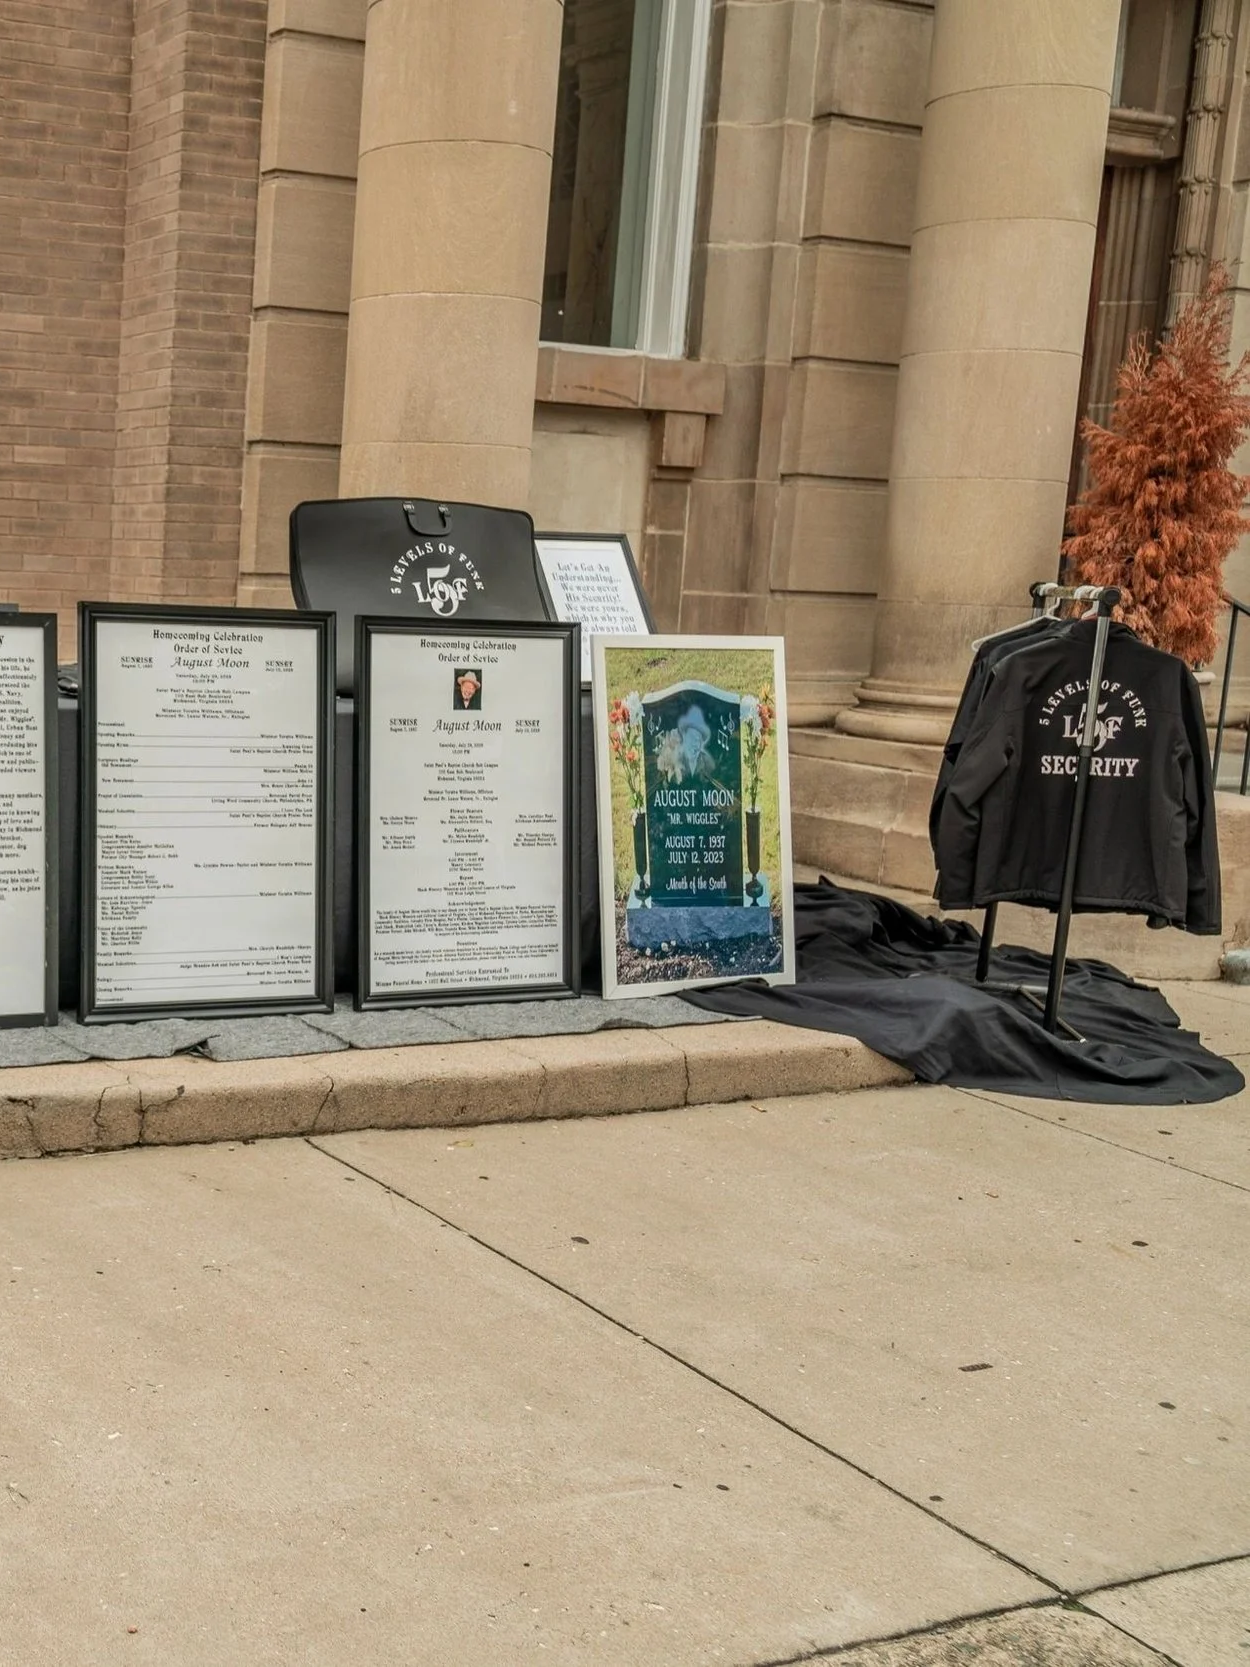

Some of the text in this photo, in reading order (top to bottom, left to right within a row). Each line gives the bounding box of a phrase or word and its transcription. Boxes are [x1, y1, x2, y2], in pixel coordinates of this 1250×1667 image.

[390, 542, 433, 583] LEVELS
[439, 543, 455, 555] OF
[459, 553, 484, 590] FUNK
[557, 562, 610, 572] Let's Get An
[560, 583, 574, 591] We
[565, 593, 621, 603] His Security!
[565, 603, 579, 612] We
[591, 614, 598, 622] is
[600, 614, 617, 623] why
[620, 616, 635, 624] you
[591, 624, 637, 633] always told
[153, 629, 264, 643] Homecoming Celebration
[173, 643, 199, 653] Order
[201, 644, 211, 654] of
[420, 638, 517, 651] Homecoming Celebration
[170, 656, 250, 670] August Moon
[437, 653, 460, 662] Order
[462, 654, 471, 663] of
[1039, 718, 1050, 726] 5
[1101, 680, 1121, 692] OF
[1122, 690, 1147, 728] FUNK
[432, 719, 470, 734] August
[472, 720, 502, 731] Moon
[1041, 755, 1140, 777] SECRITY
[654, 790, 734, 807] AUGUST MOON
[665, 836, 695, 848] AUGUST
[710, 836, 725, 848] 1937
[668, 852, 687, 864] JULY
[704, 852, 724, 864] 2023
[666, 875, 727, 894] Mouth of the South
